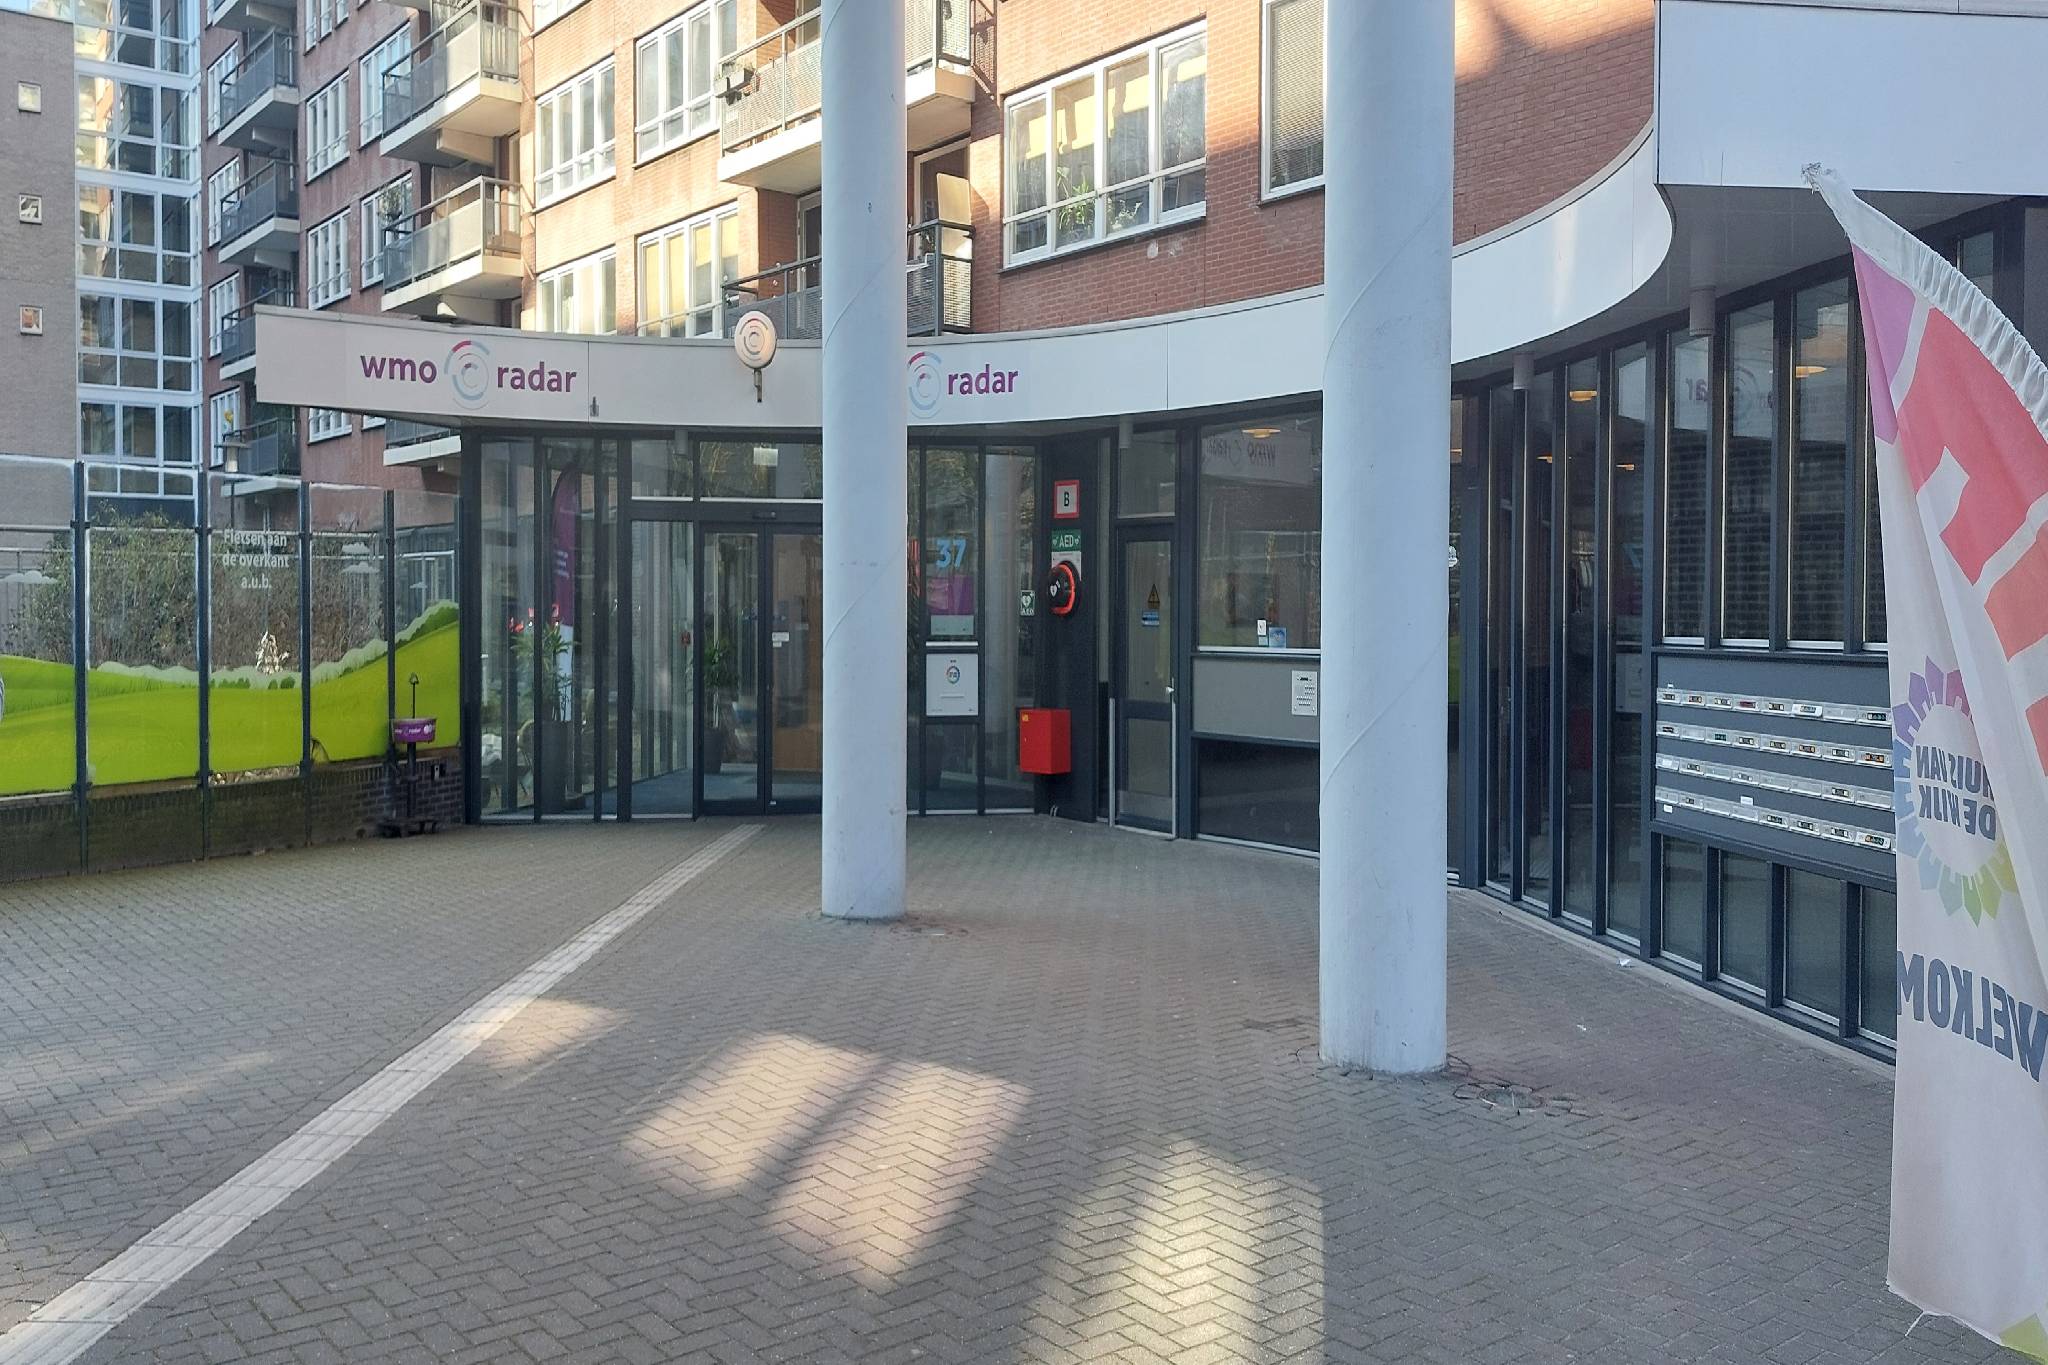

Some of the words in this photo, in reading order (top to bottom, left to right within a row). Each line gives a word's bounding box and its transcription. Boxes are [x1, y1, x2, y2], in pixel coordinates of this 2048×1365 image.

[359, 354, 437, 384] wmo
[497, 360, 577, 393] radar
[947, 363, 1019, 396] radar
[1063, 491, 1070, 507] B
[224, 529, 265, 545] Fietsen
[267, 534, 287, 546] aan
[1059, 535, 1074, 548] AED
[222, 550, 236, 567] de
[239, 552, 290, 567] overkant
[936, 538, 966, 569] 37
[242, 574, 271, 588] a.u.b.
